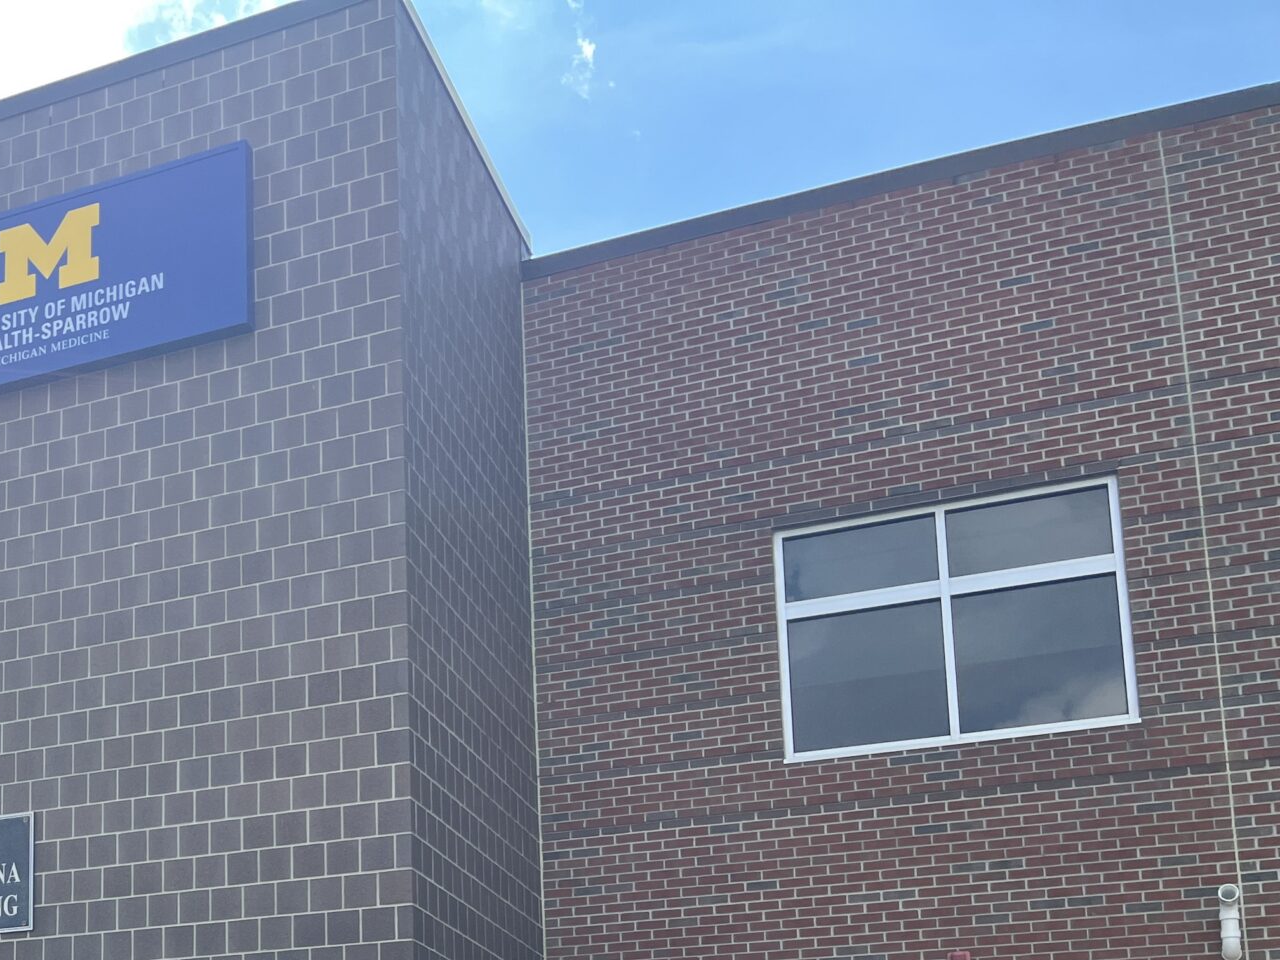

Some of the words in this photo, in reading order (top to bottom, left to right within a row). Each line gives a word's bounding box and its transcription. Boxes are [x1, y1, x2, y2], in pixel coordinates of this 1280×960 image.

[44, 299, 66, 320] OF
[71, 272, 164, 313] MICHIGAN
[50, 329, 110, 353] MEDICINE
